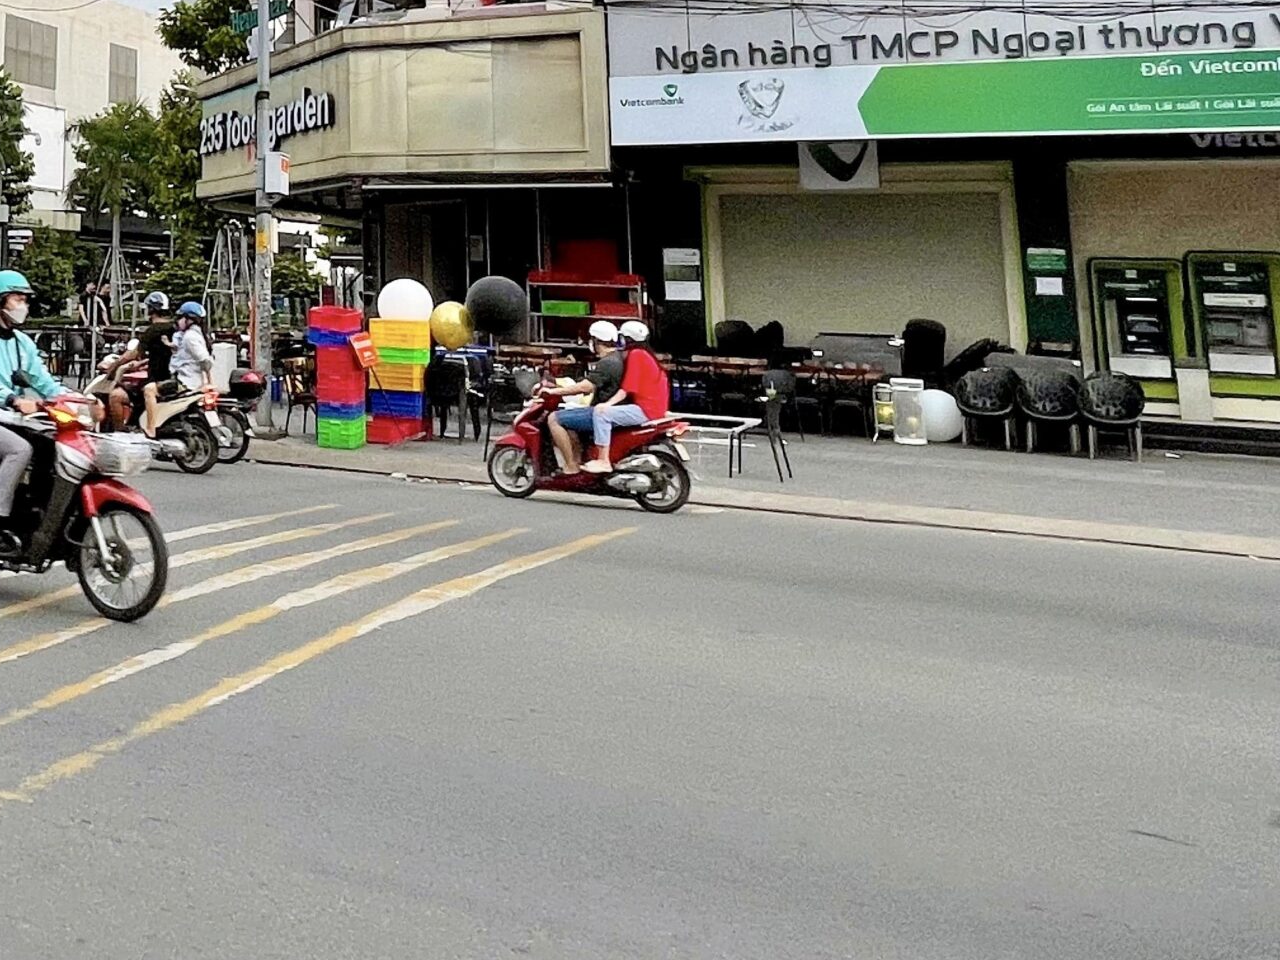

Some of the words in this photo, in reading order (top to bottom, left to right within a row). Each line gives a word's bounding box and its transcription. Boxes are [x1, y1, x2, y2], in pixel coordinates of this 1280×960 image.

[656, 43, 740, 74] Ngân
[748, 40, 832, 68] hàng
[841, 29, 959, 61] TMCP
[971, 25, 1086, 58] Ngoại
[1140, 59, 1183, 77] Đến
[200, 112, 224, 155] 255
